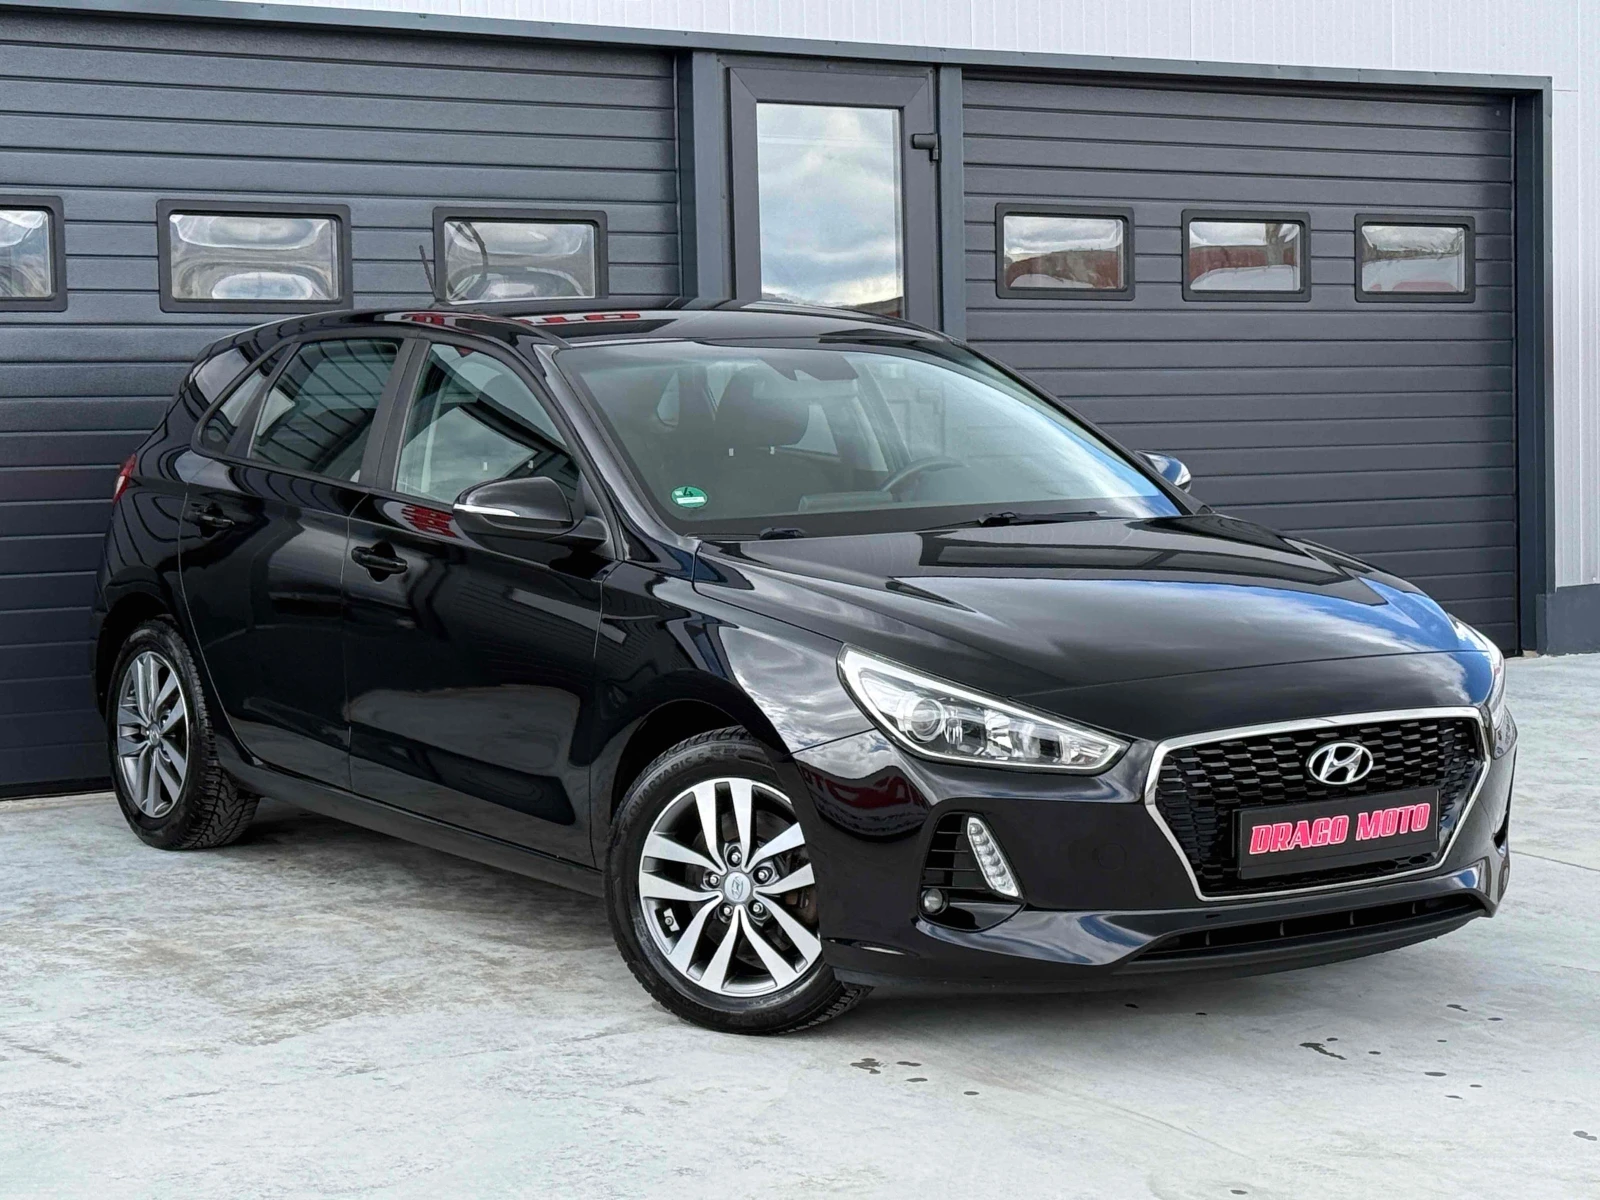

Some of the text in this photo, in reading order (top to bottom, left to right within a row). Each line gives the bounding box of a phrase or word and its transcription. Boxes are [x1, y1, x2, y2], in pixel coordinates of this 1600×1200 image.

[628, 757, 694, 817] QUARTARIS
[1249, 803, 1431, 854] DRAGO MOTO
